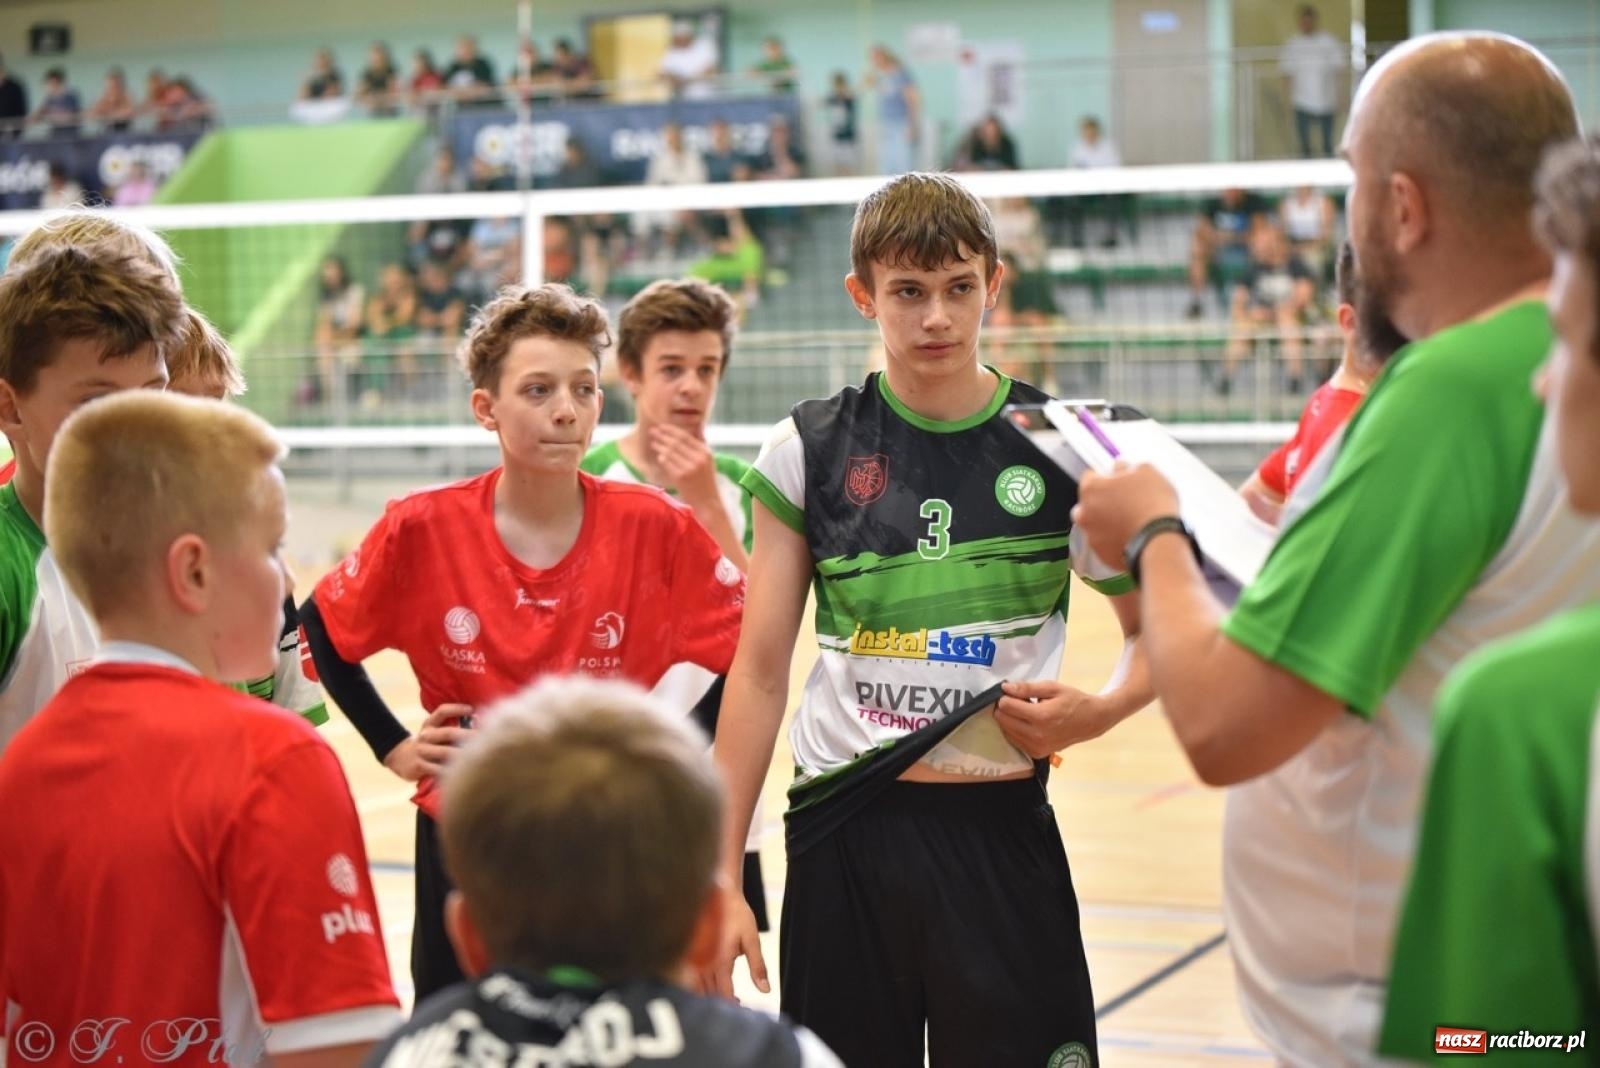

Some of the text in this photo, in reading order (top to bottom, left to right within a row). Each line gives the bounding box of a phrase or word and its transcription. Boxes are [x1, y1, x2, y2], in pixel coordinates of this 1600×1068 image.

[917, 498, 953, 560] 3
[850, 622, 997, 666] instal-tech
[321, 903, 375, 943] plu
